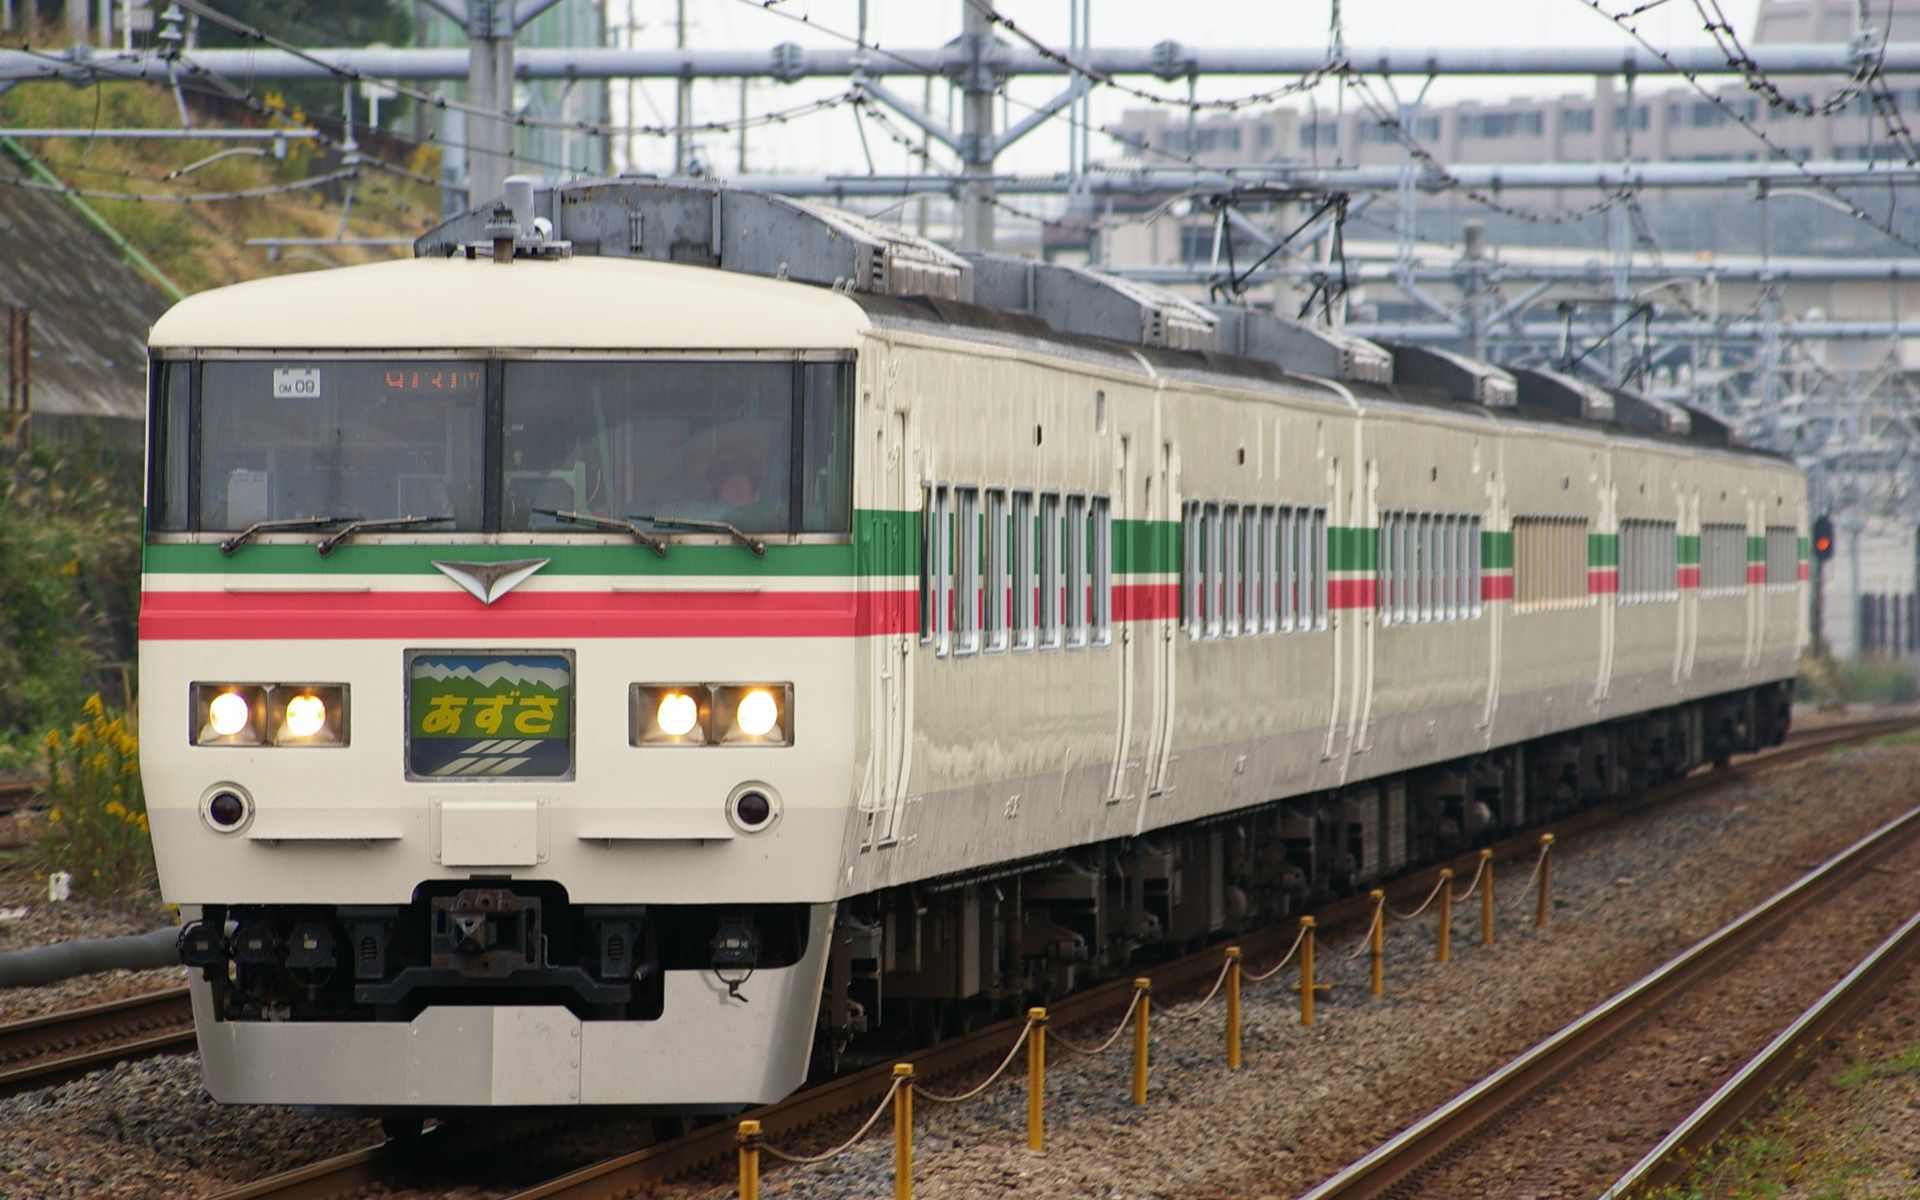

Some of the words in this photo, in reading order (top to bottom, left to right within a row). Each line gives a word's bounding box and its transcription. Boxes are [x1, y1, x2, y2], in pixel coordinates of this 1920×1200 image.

[295, 379, 315, 394] 09
[422, 690, 559, 735] あずさ
